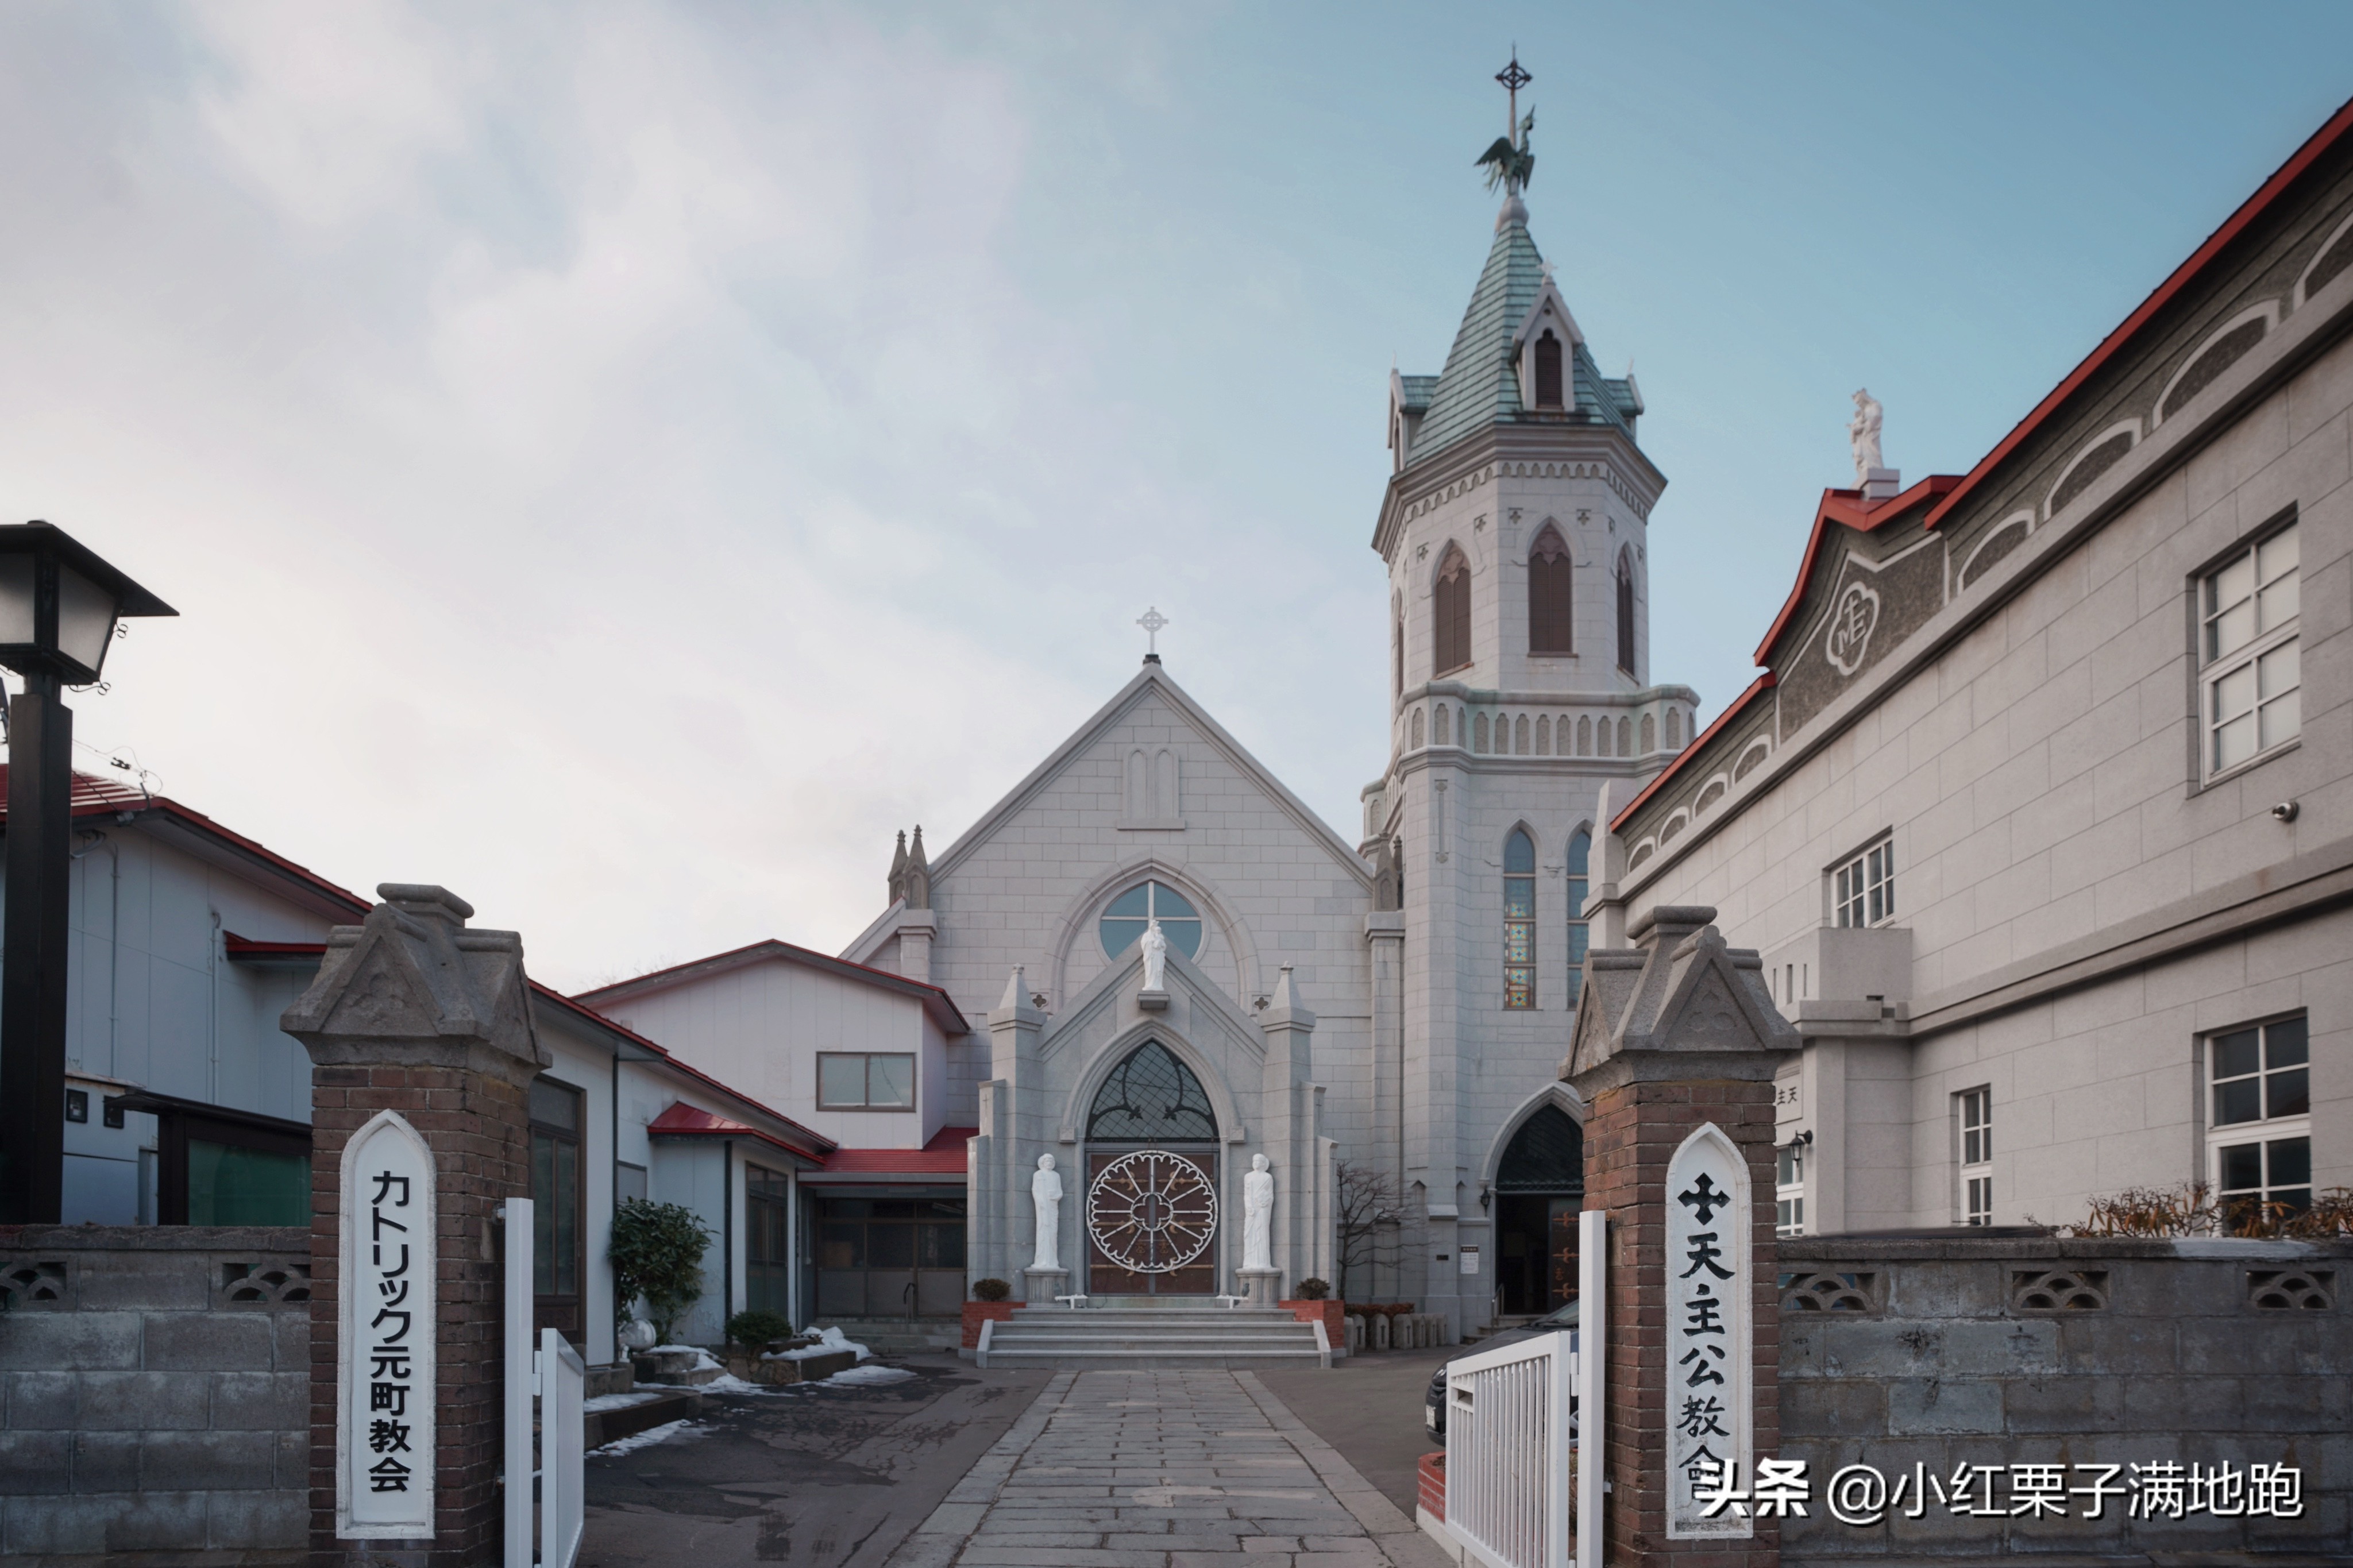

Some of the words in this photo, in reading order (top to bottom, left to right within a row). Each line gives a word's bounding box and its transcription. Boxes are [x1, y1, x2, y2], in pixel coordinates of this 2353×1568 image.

[369, 1171, 411, 1492] カトリック元町教会
